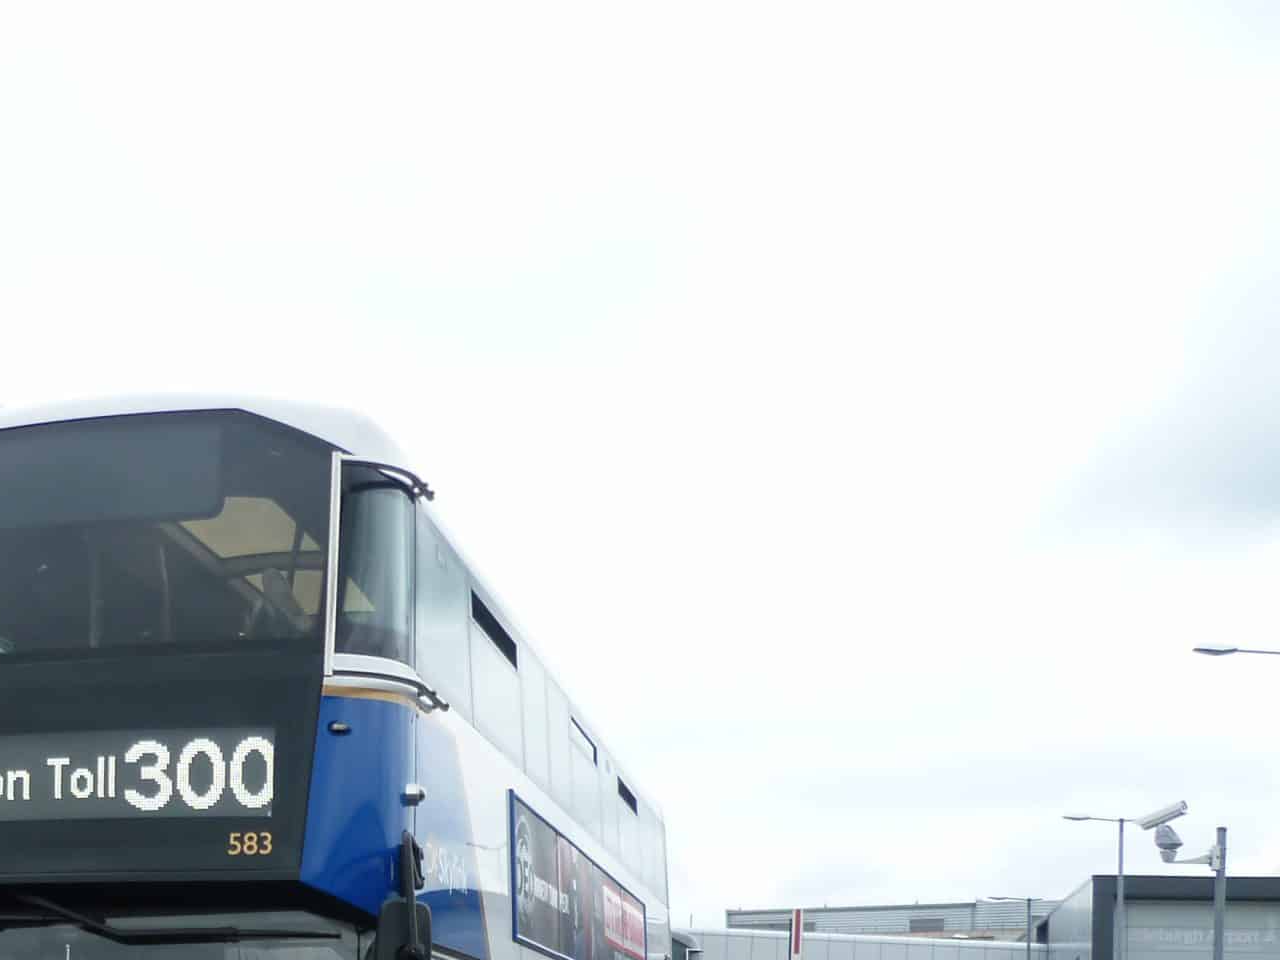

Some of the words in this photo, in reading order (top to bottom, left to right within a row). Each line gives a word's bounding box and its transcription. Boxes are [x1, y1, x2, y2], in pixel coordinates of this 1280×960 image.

[47, 755, 116, 800] Toll
[123, 735, 276, 812] 300
[226, 832, 274, 856] 583
